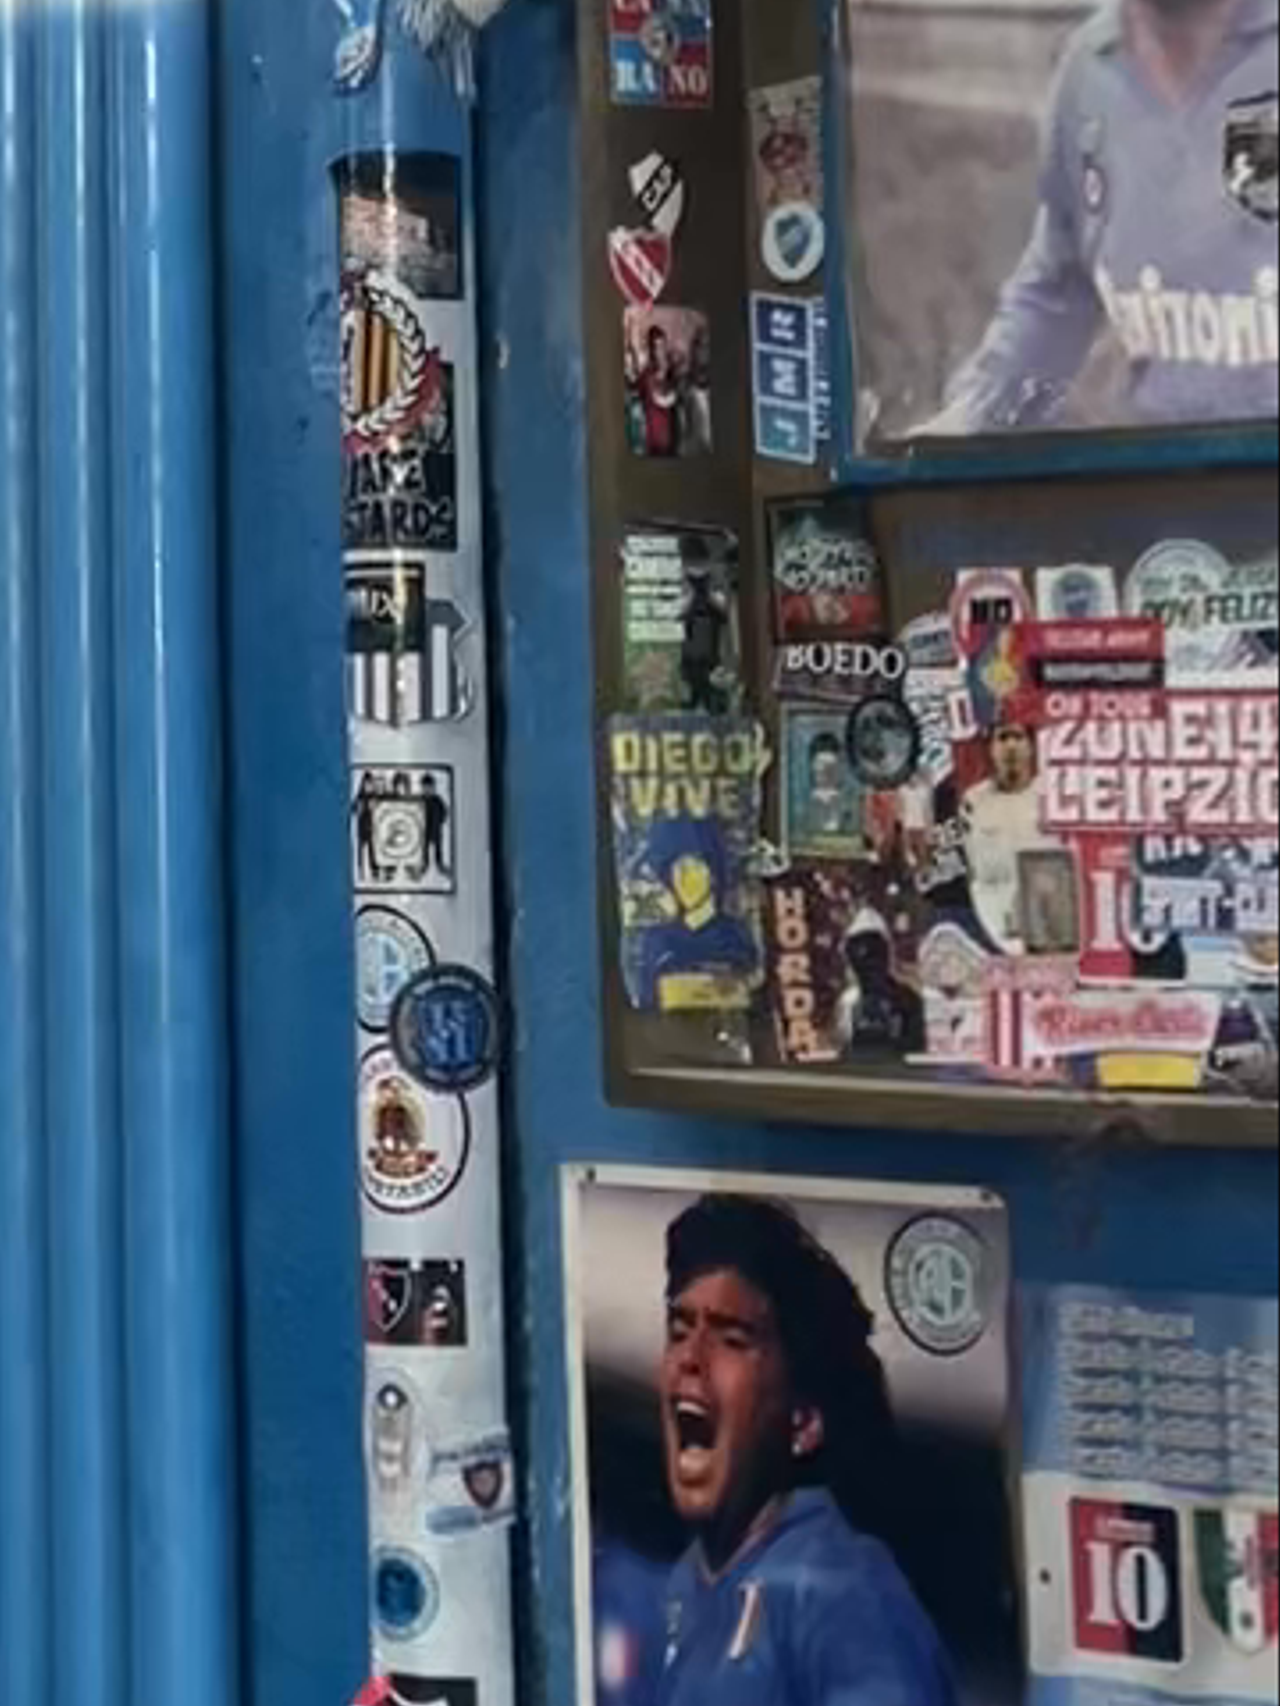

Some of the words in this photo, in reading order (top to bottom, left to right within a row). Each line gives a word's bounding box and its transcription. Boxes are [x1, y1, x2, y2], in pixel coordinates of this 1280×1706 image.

[786, 642, 906, 680] BOEDO
[612, 731, 755, 775] DIEGO
[628, 776, 742, 820] VIVE
[1084, 1540, 1168, 1632] 10
